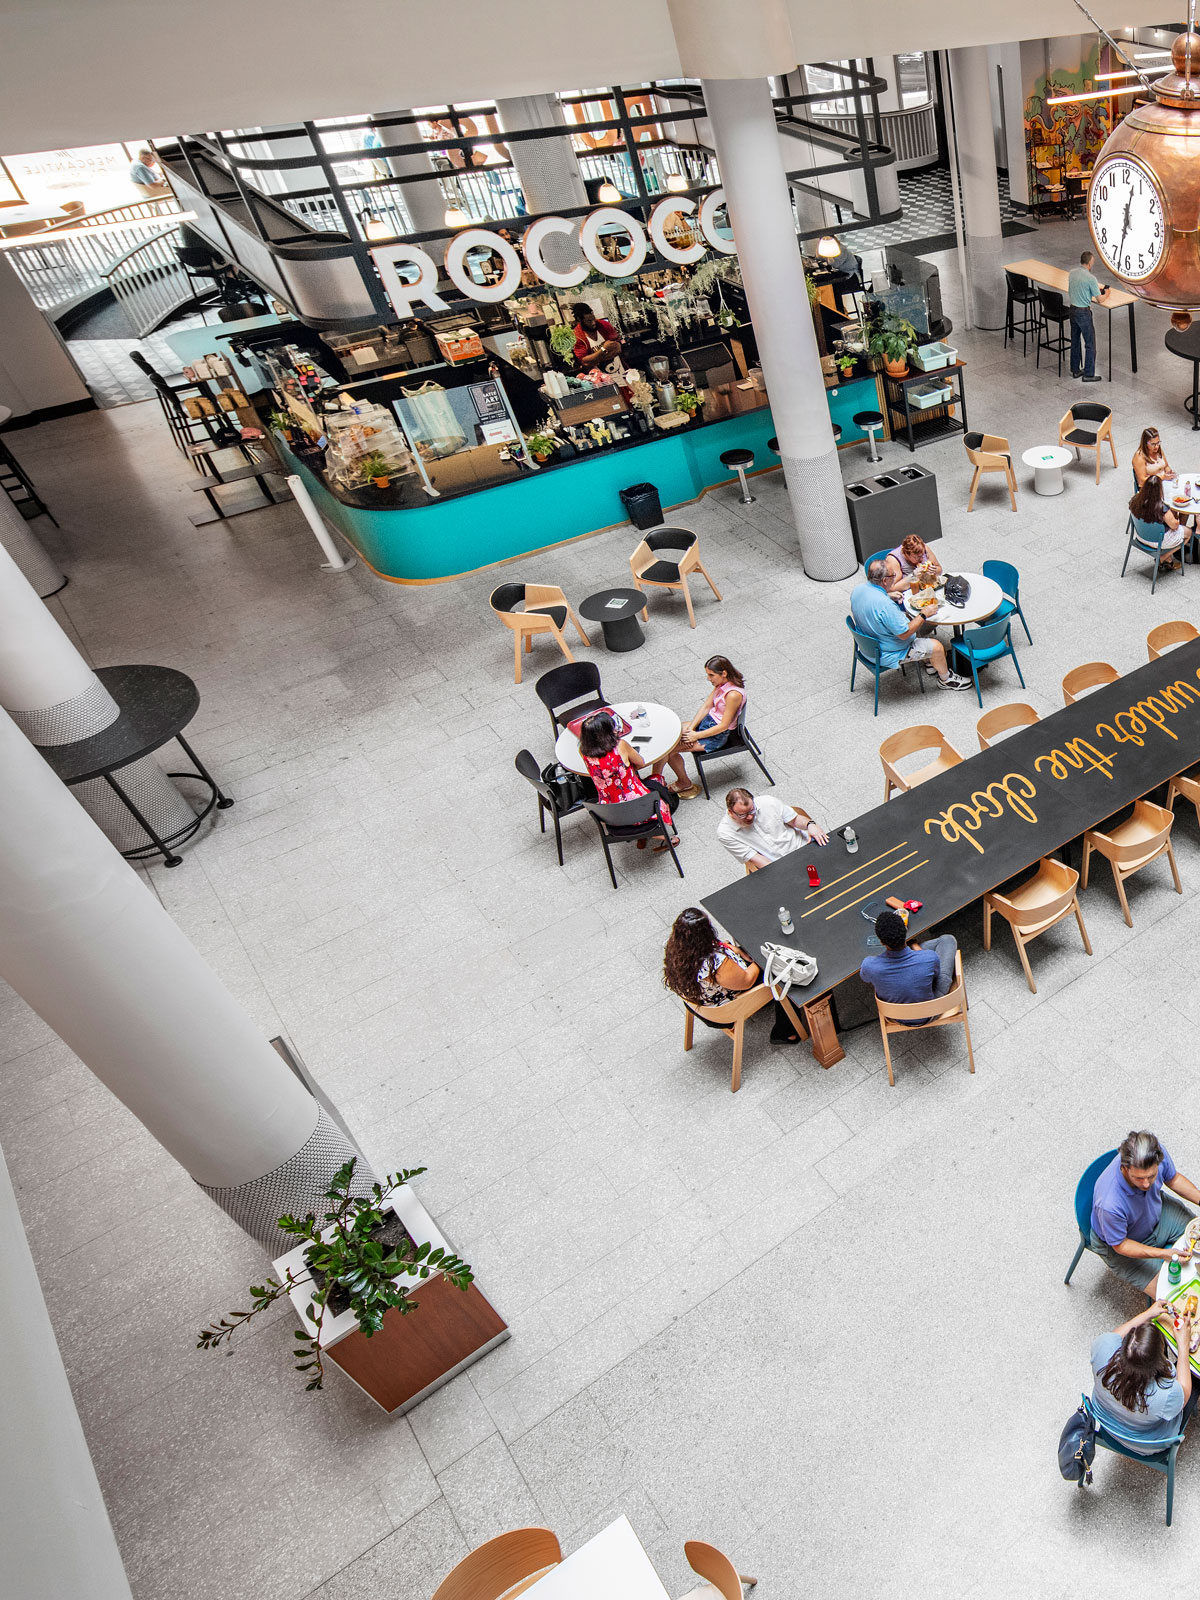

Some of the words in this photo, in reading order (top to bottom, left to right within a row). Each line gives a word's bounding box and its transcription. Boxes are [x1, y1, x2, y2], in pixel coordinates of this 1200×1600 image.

[1109, 172, 1116, 188] 11
[1122, 169, 1131, 185] 12
[1099, 185, 1108, 201] 10
[1138, 179, 1143, 195] 1
[1095, 205, 1102, 221] 9
[1149, 199, 1155, 214] 2
[1101, 228, 1107, 244] 8
[1154, 222, 1160, 237] 3
[1112, 245, 1118, 260] 7
[1147, 242, 1155, 258] 4
[1124, 255, 1131, 270] 6
[1138, 254, 1145, 269] 5
[485, 395, 499, 404] ART
[1034, 737, 1118, 780] the
[923, 772, 1038, 855] clock
